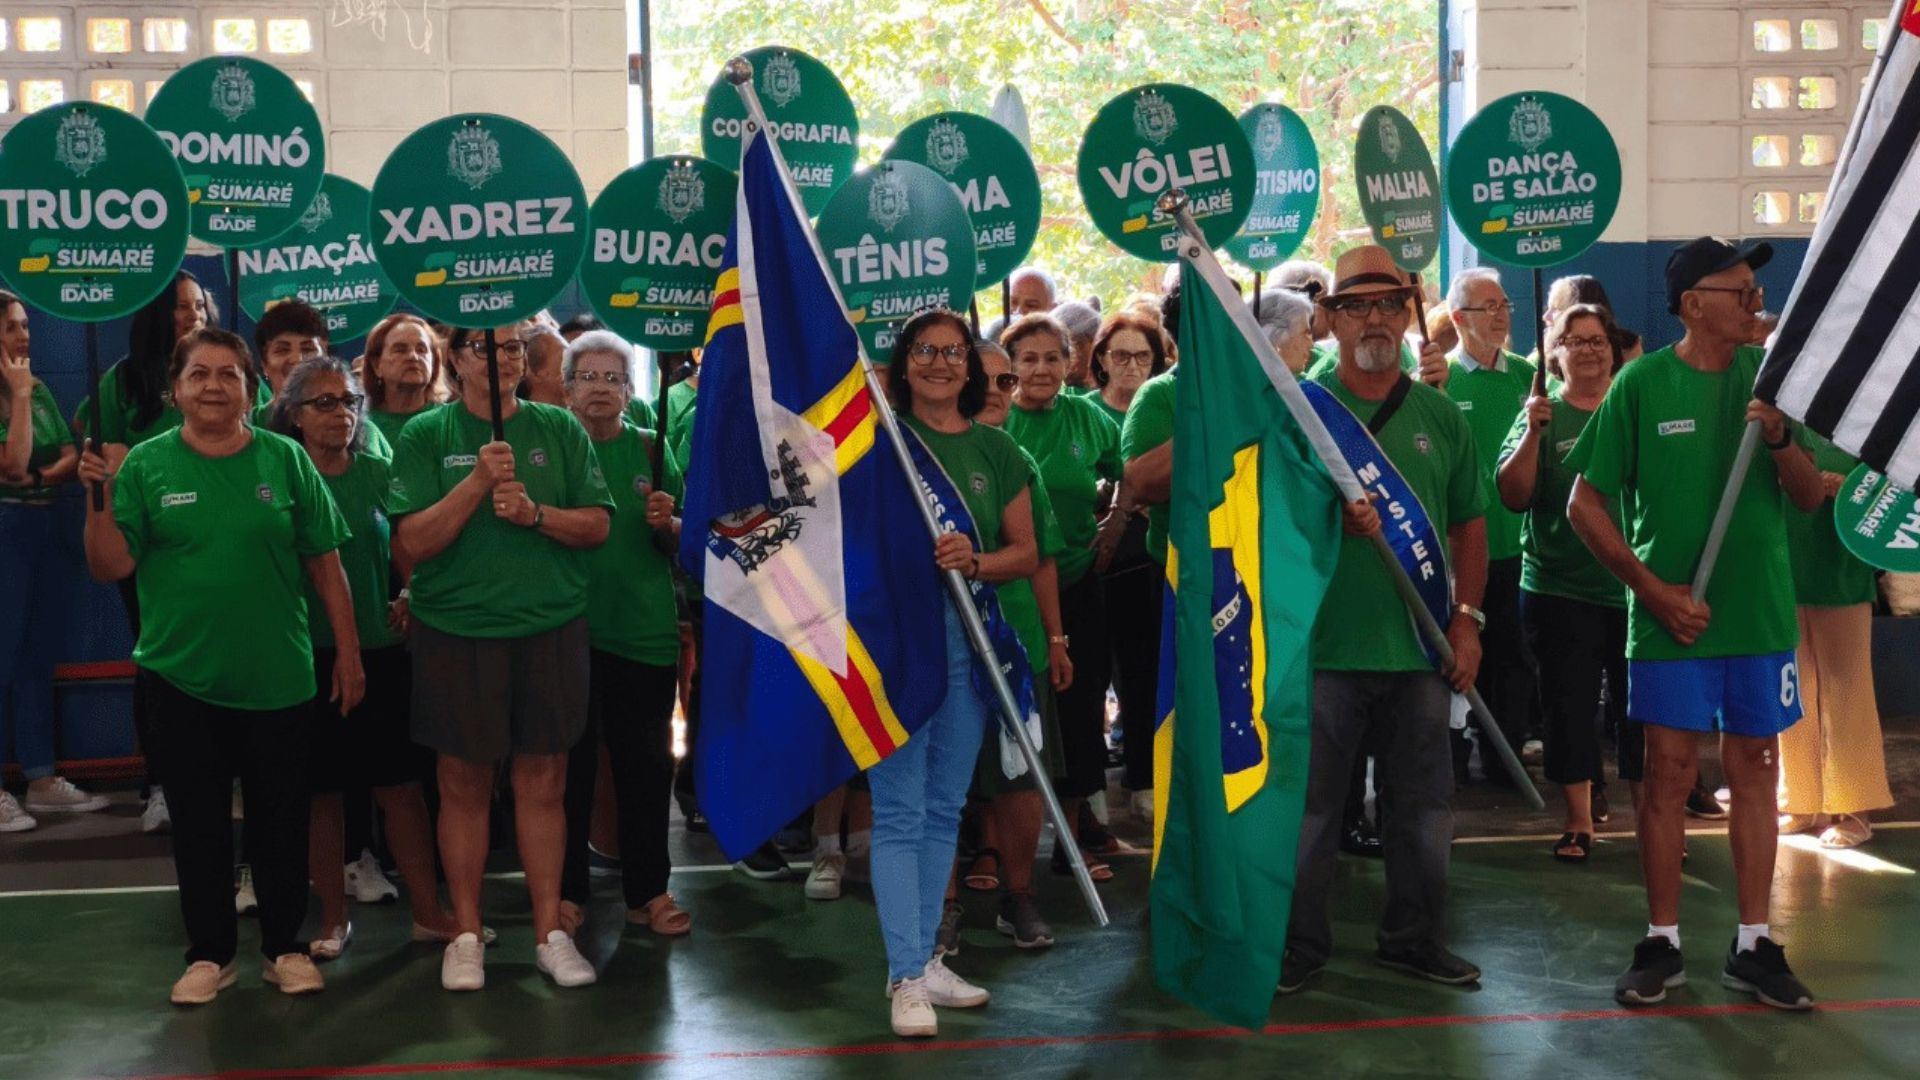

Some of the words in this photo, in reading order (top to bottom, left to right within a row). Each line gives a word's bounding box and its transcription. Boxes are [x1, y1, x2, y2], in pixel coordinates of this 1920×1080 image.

[712, 117, 852, 145] COOGRAFIA
[159, 127, 310, 167] DOMINÓ
[789, 164, 833, 182] MARÉ
[1098, 144, 1232, 199] VÔLEI
[1488, 150, 1578, 178] DANÇA
[207, 182, 293, 202] SUMARÉ
[948, 175, 1011, 213] MA
[1256, 168, 1316, 195] TISMO
[1366, 170, 1431, 203] MALHA
[1472, 181, 1504, 203] DE
[1513, 169, 1597, 199] SALÃO
[0, 188, 168, 230] TRUCO
[1152, 188, 1232, 221] SARÉ
[1513, 200, 1594, 225] SUMARÉ
[209, 218, 256, 232] IDADE
[378, 197, 575, 246] XADREZ
[974, 221, 1016, 245] ARÉ
[1248, 210, 1300, 230] SUMARÉ
[1396, 210, 1434, 231] SUMARÉ
[57, 243, 155, 267] SUMARÉ
[594, 227, 727, 268] BURAC
[834, 233, 949, 285] TÊNIS
[1517, 239, 1562, 255] IDADE
[454, 249, 554, 278] SUMARÉ
[61, 287, 115, 302] IDADE
[297, 280, 379, 302] SUMARÉ
[460, 294, 514, 313] IDADE
[645, 286, 715, 305] SUMA
[645, 321, 694, 336] IDADE
[1358, 461, 1434, 581] MISTER
[1859, 483, 1900, 538] UMARÉ
[1781, 662, 1795, 707] 6
